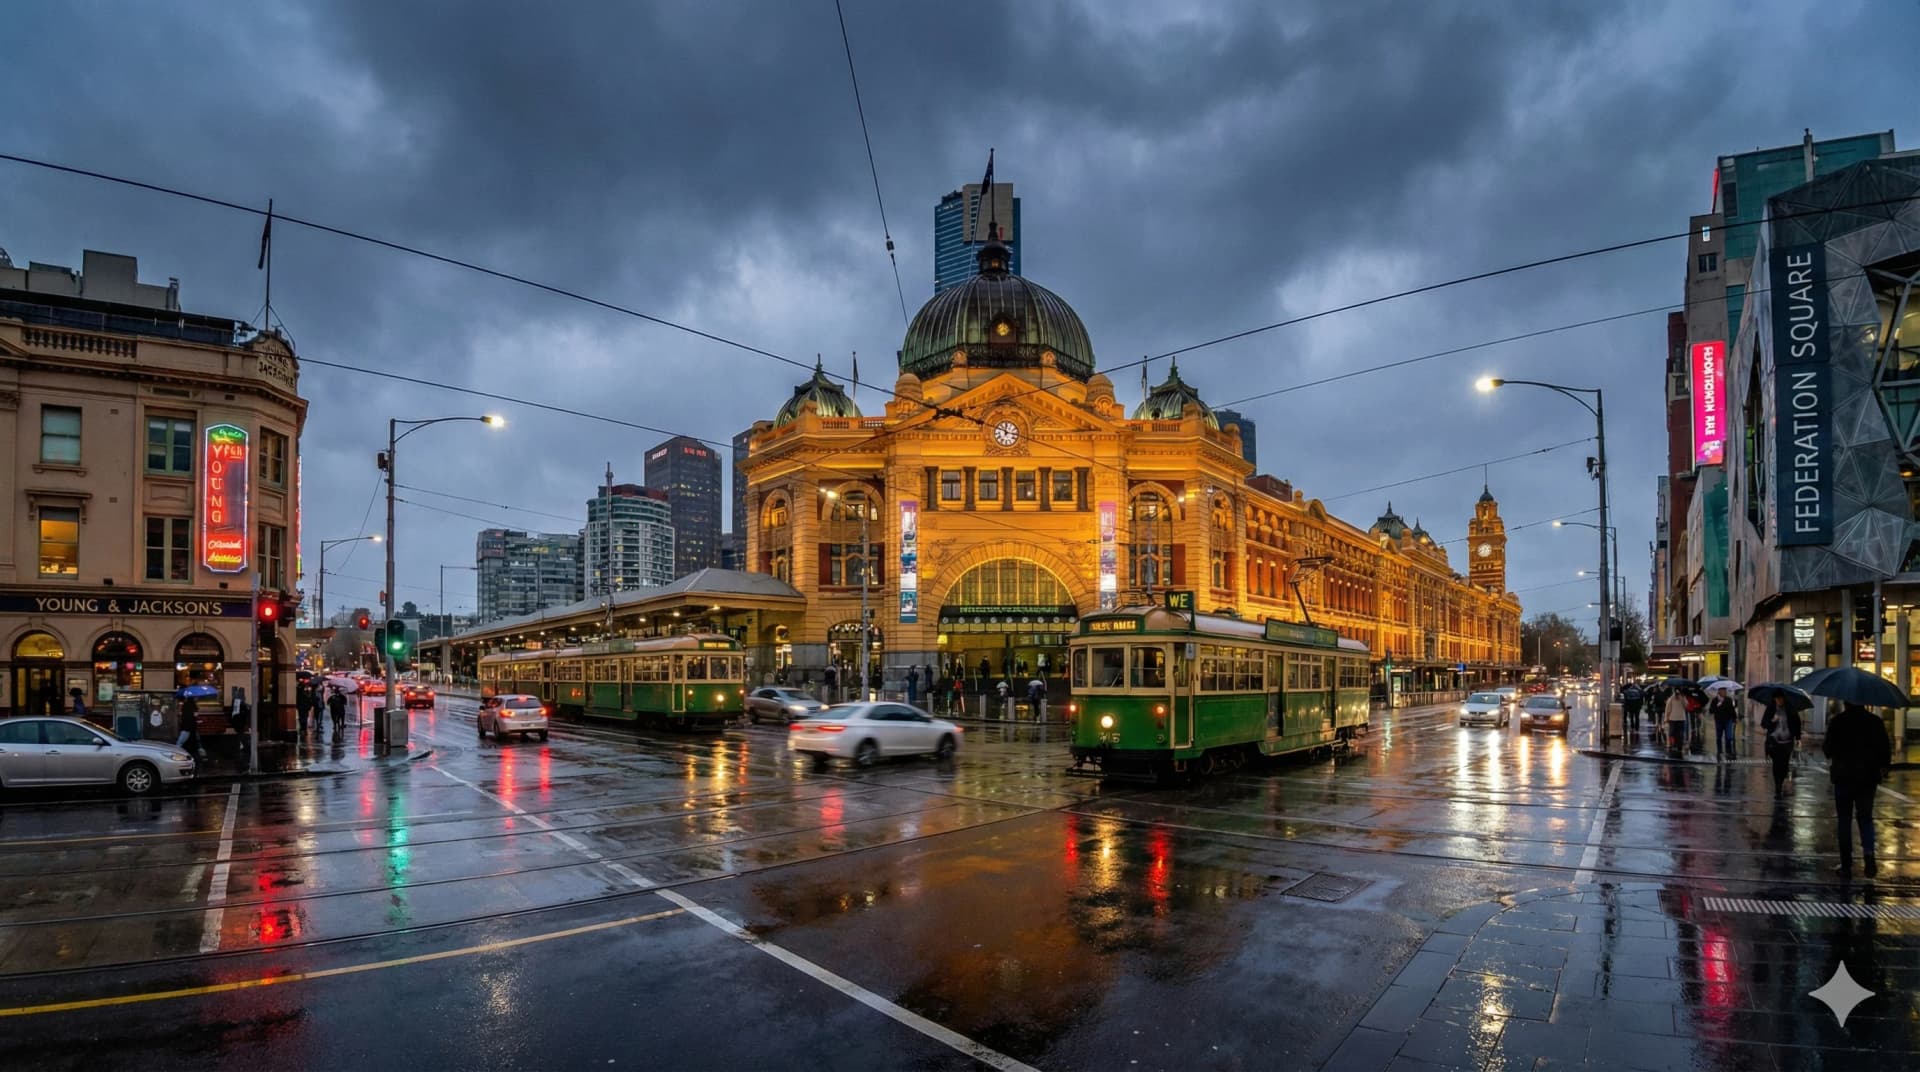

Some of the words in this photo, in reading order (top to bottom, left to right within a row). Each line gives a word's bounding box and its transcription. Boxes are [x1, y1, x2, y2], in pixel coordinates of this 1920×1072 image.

[1787, 251, 1818, 358] SQUARE
[1791, 371, 1820, 533] FEDERATION
[35, 597, 99, 612] YOUNG
[107, 599, 121, 613] &
[128, 599, 223, 615] JACKSON'S
[1169, 593, 1189, 608] WE
